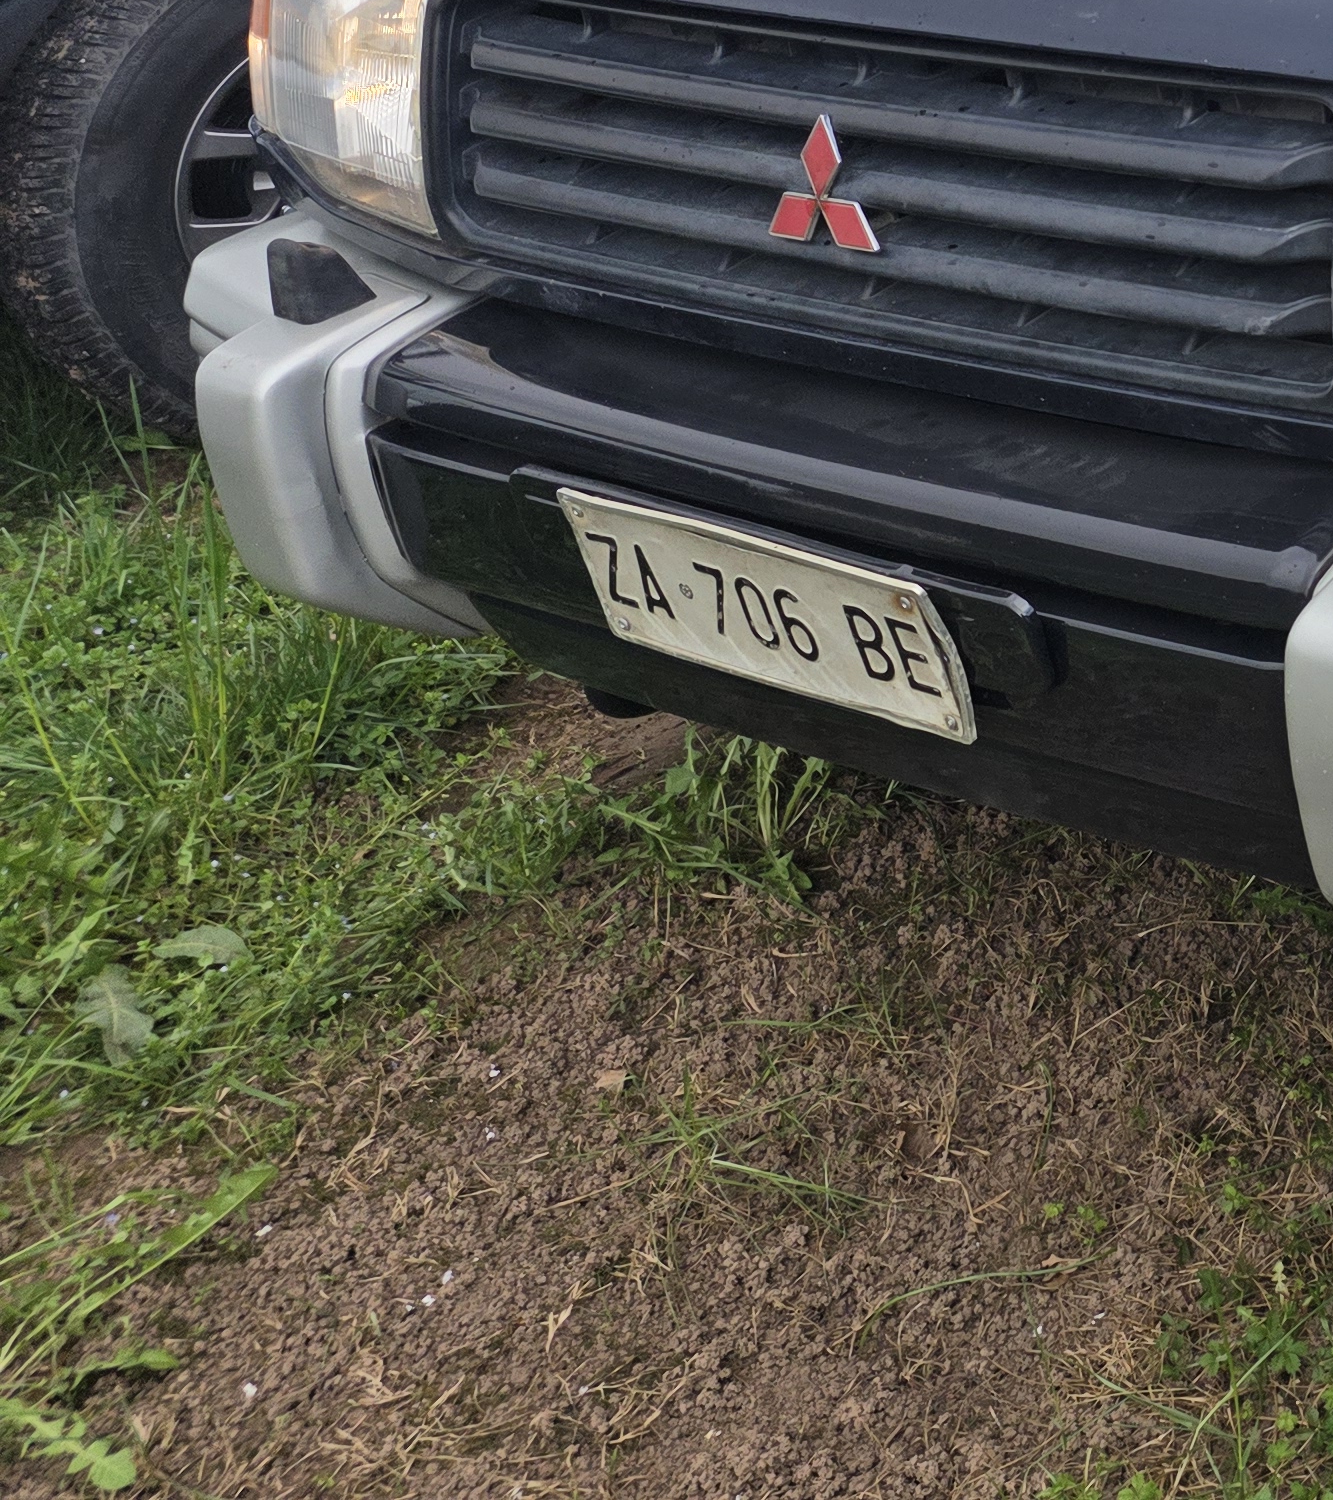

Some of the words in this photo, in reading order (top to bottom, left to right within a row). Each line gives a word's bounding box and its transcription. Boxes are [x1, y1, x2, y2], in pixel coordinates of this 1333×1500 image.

[585, 532, 675, 619] ZA
[692, 562, 819, 662] 706
[842, 605, 942, 697] BE
